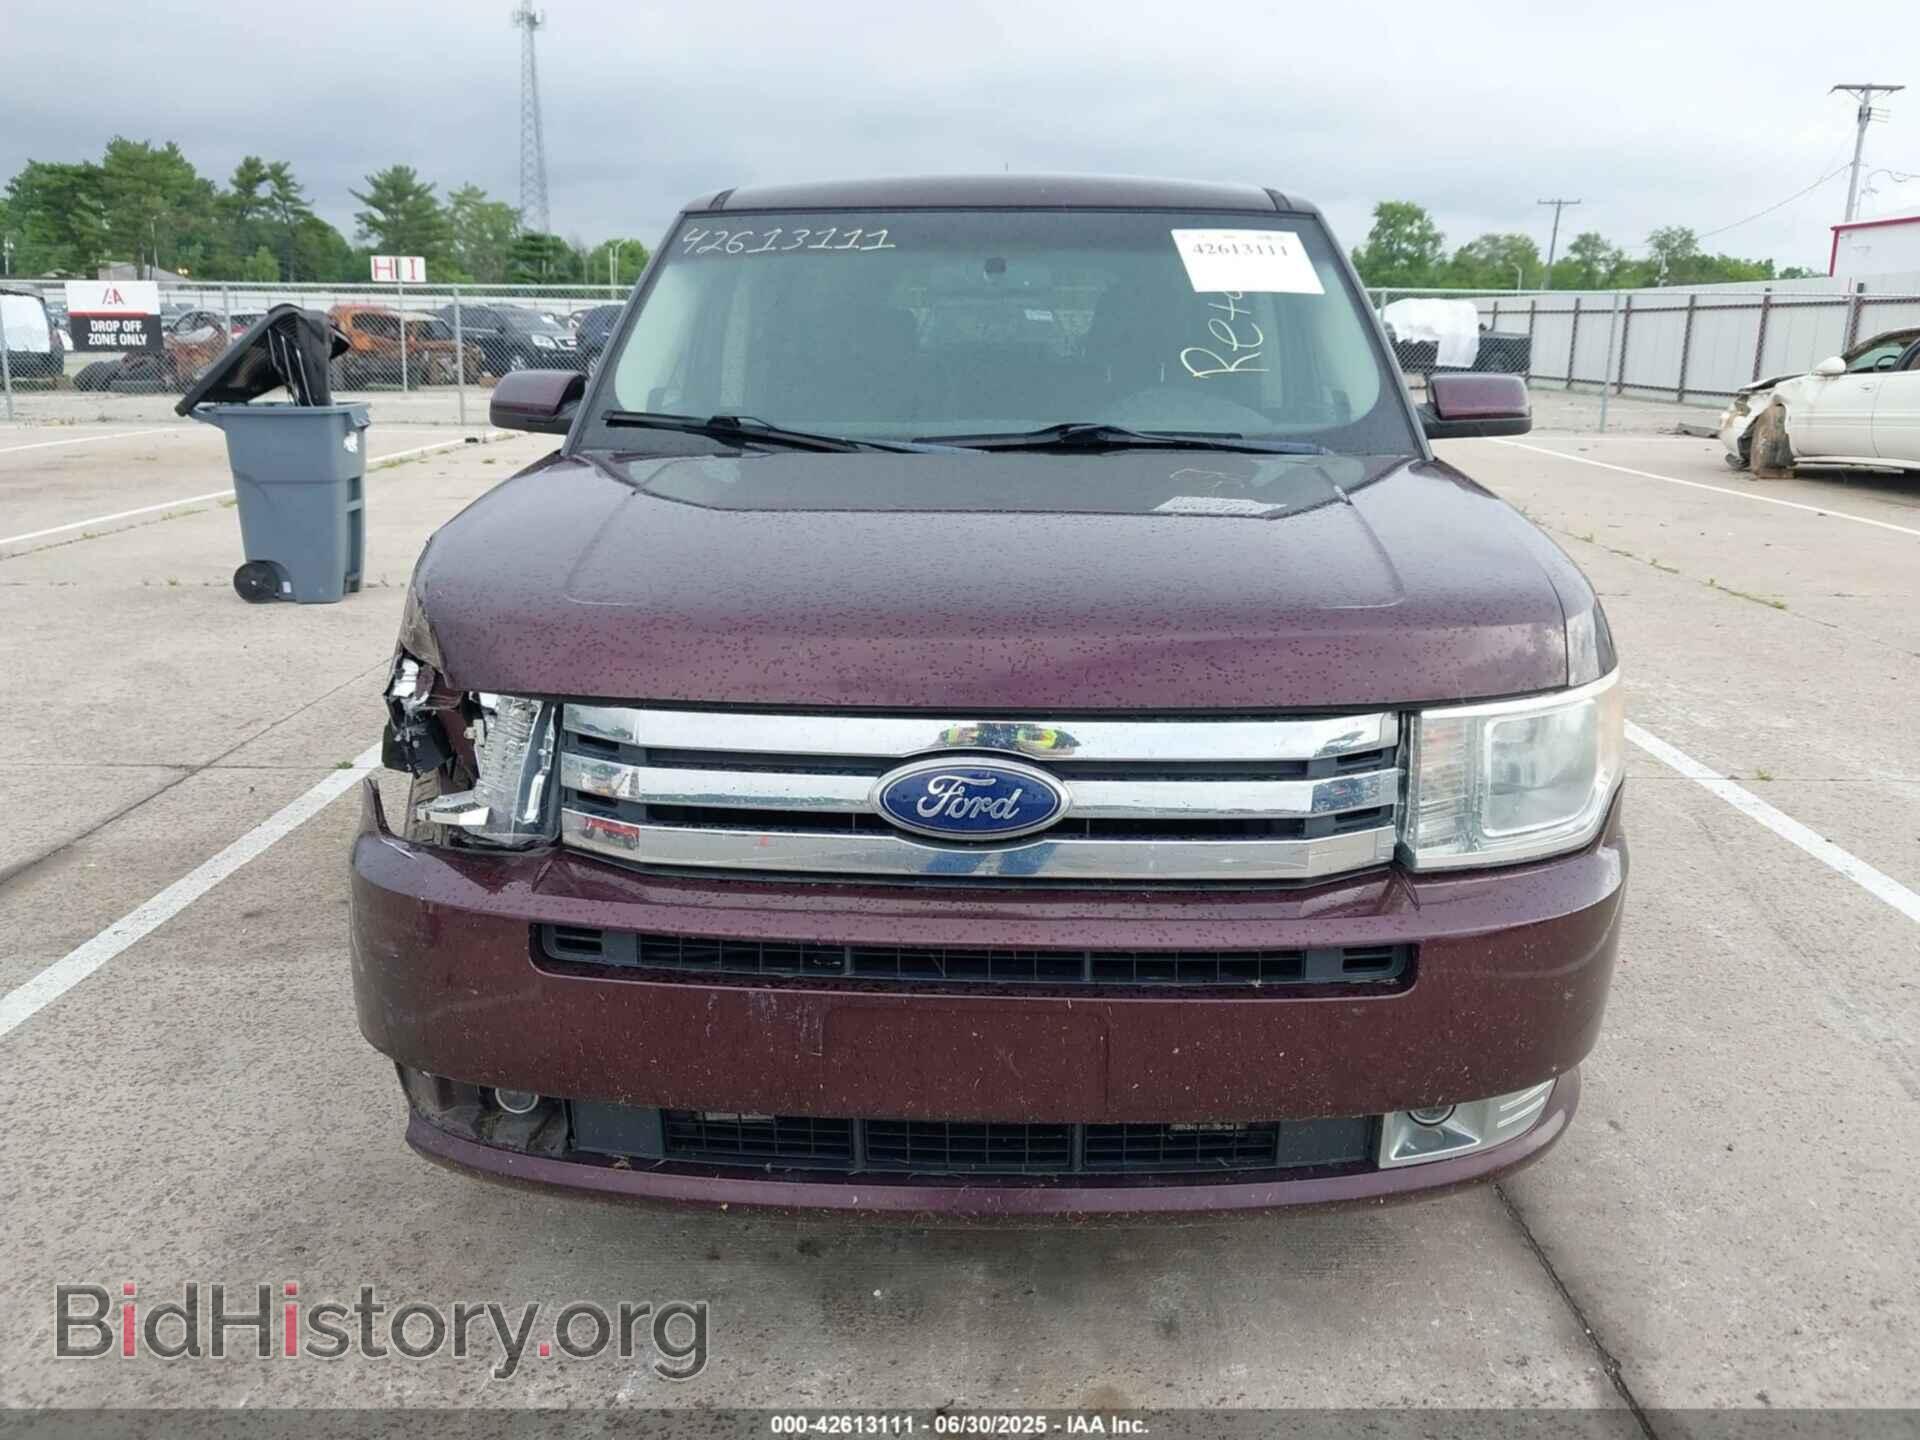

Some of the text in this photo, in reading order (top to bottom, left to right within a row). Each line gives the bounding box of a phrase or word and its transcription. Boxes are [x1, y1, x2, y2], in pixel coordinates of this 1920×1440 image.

[683, 227, 896, 254] 42613111
[1193, 243, 1288, 257] 42613111
[90, 320, 143, 332] DROP OFF
[88, 333, 147, 346] ZONE ONLY
[916, 774, 1023, 820] Ford
